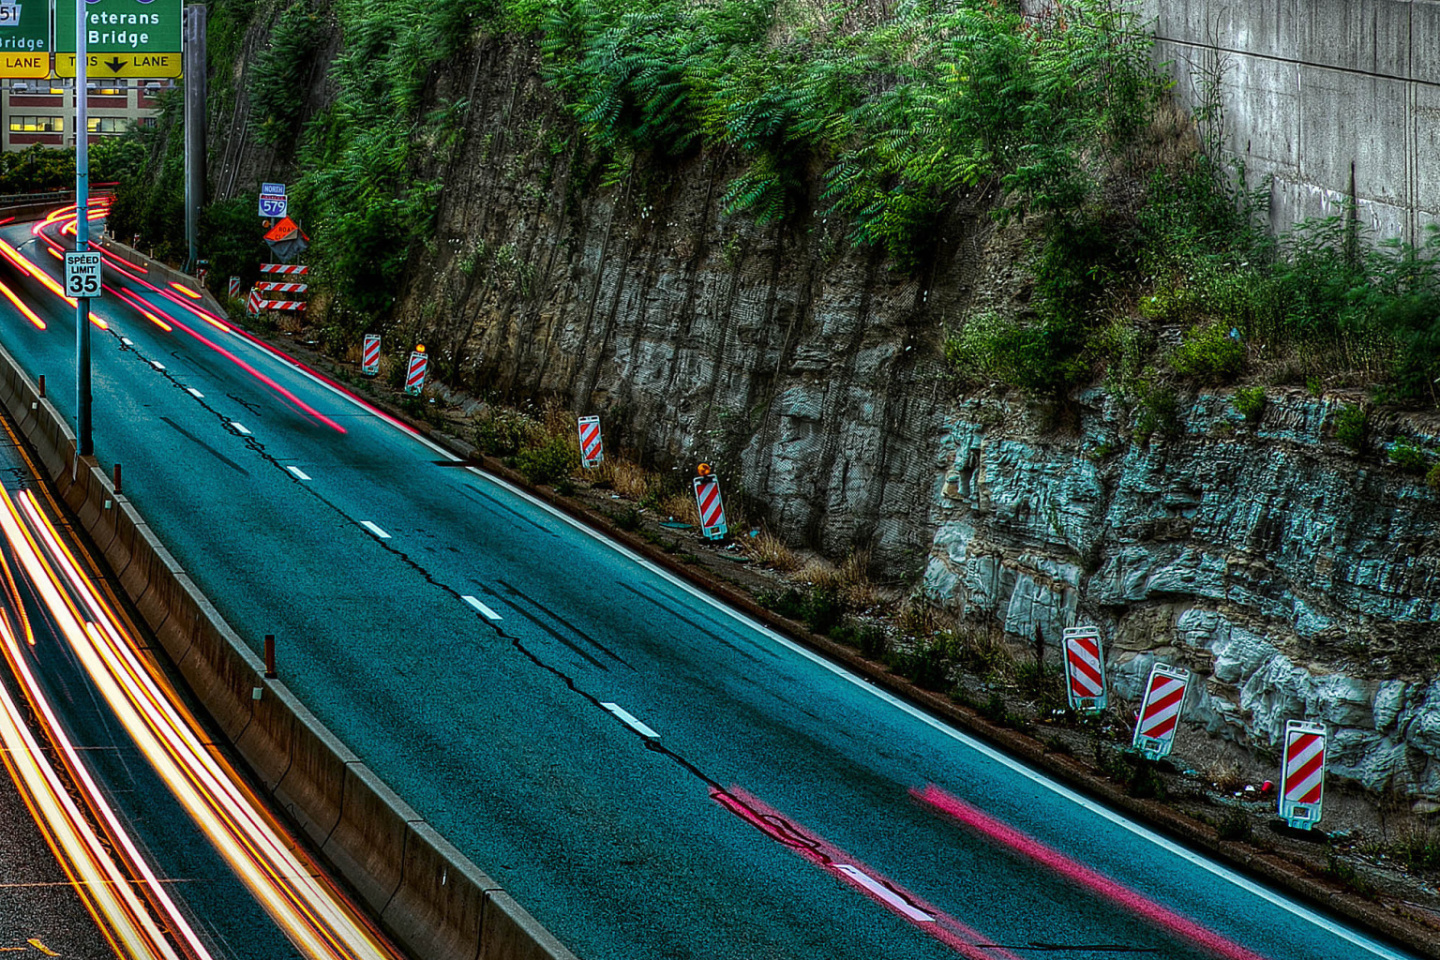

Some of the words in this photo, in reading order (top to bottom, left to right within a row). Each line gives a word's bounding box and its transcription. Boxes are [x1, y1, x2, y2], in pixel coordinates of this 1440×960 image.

[0, 6, 17, 21] 51
[88, 30, 149, 48] Bridge
[6, 57, 41, 68] LANE
[69, 56, 98, 67] TIS
[134, 56, 169, 67] LANE
[264, 185, 283, 193] NORTH
[263, 200, 285, 212] 579
[67, 256, 99, 265] SPEED
[71, 266, 96, 274] LIMIT
[69, 275, 98, 293] 35
